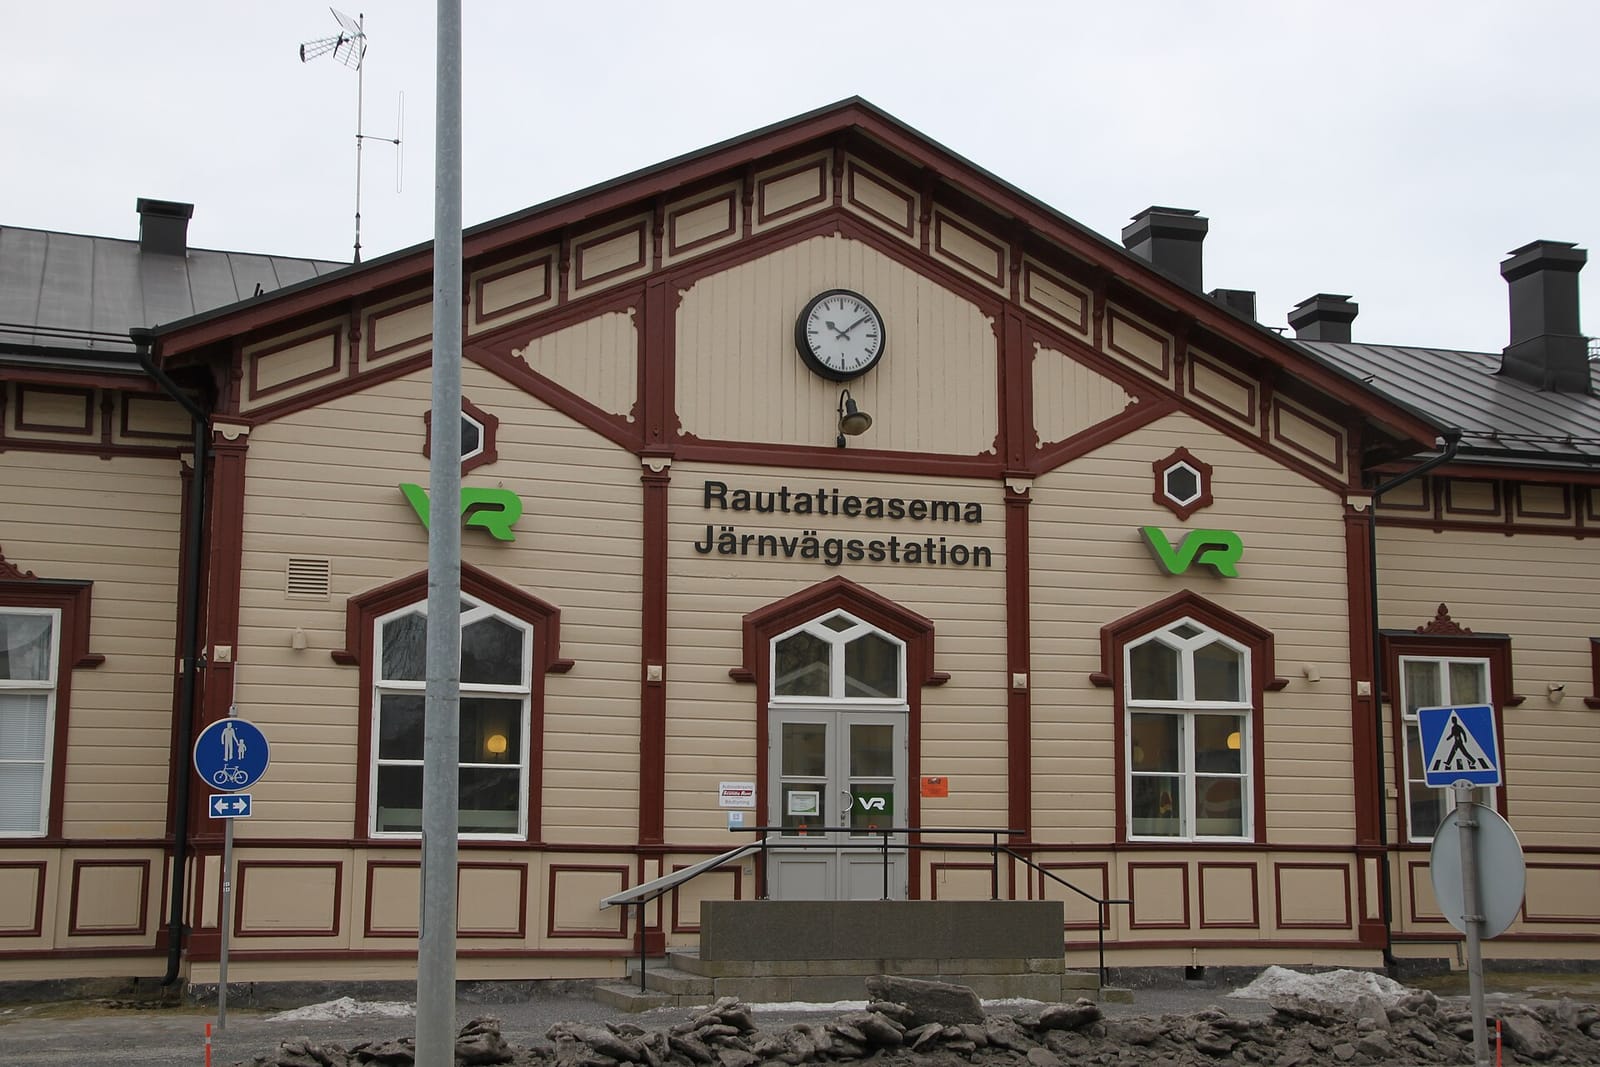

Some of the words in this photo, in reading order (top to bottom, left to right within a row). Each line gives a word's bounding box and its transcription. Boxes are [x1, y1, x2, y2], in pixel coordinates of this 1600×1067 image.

[704, 480, 983, 523] Rautatieasema
[694, 525, 992, 567] Järnvägsstation
[1140, 526, 1243, 577] VR
[858, 797, 886, 810] VR
